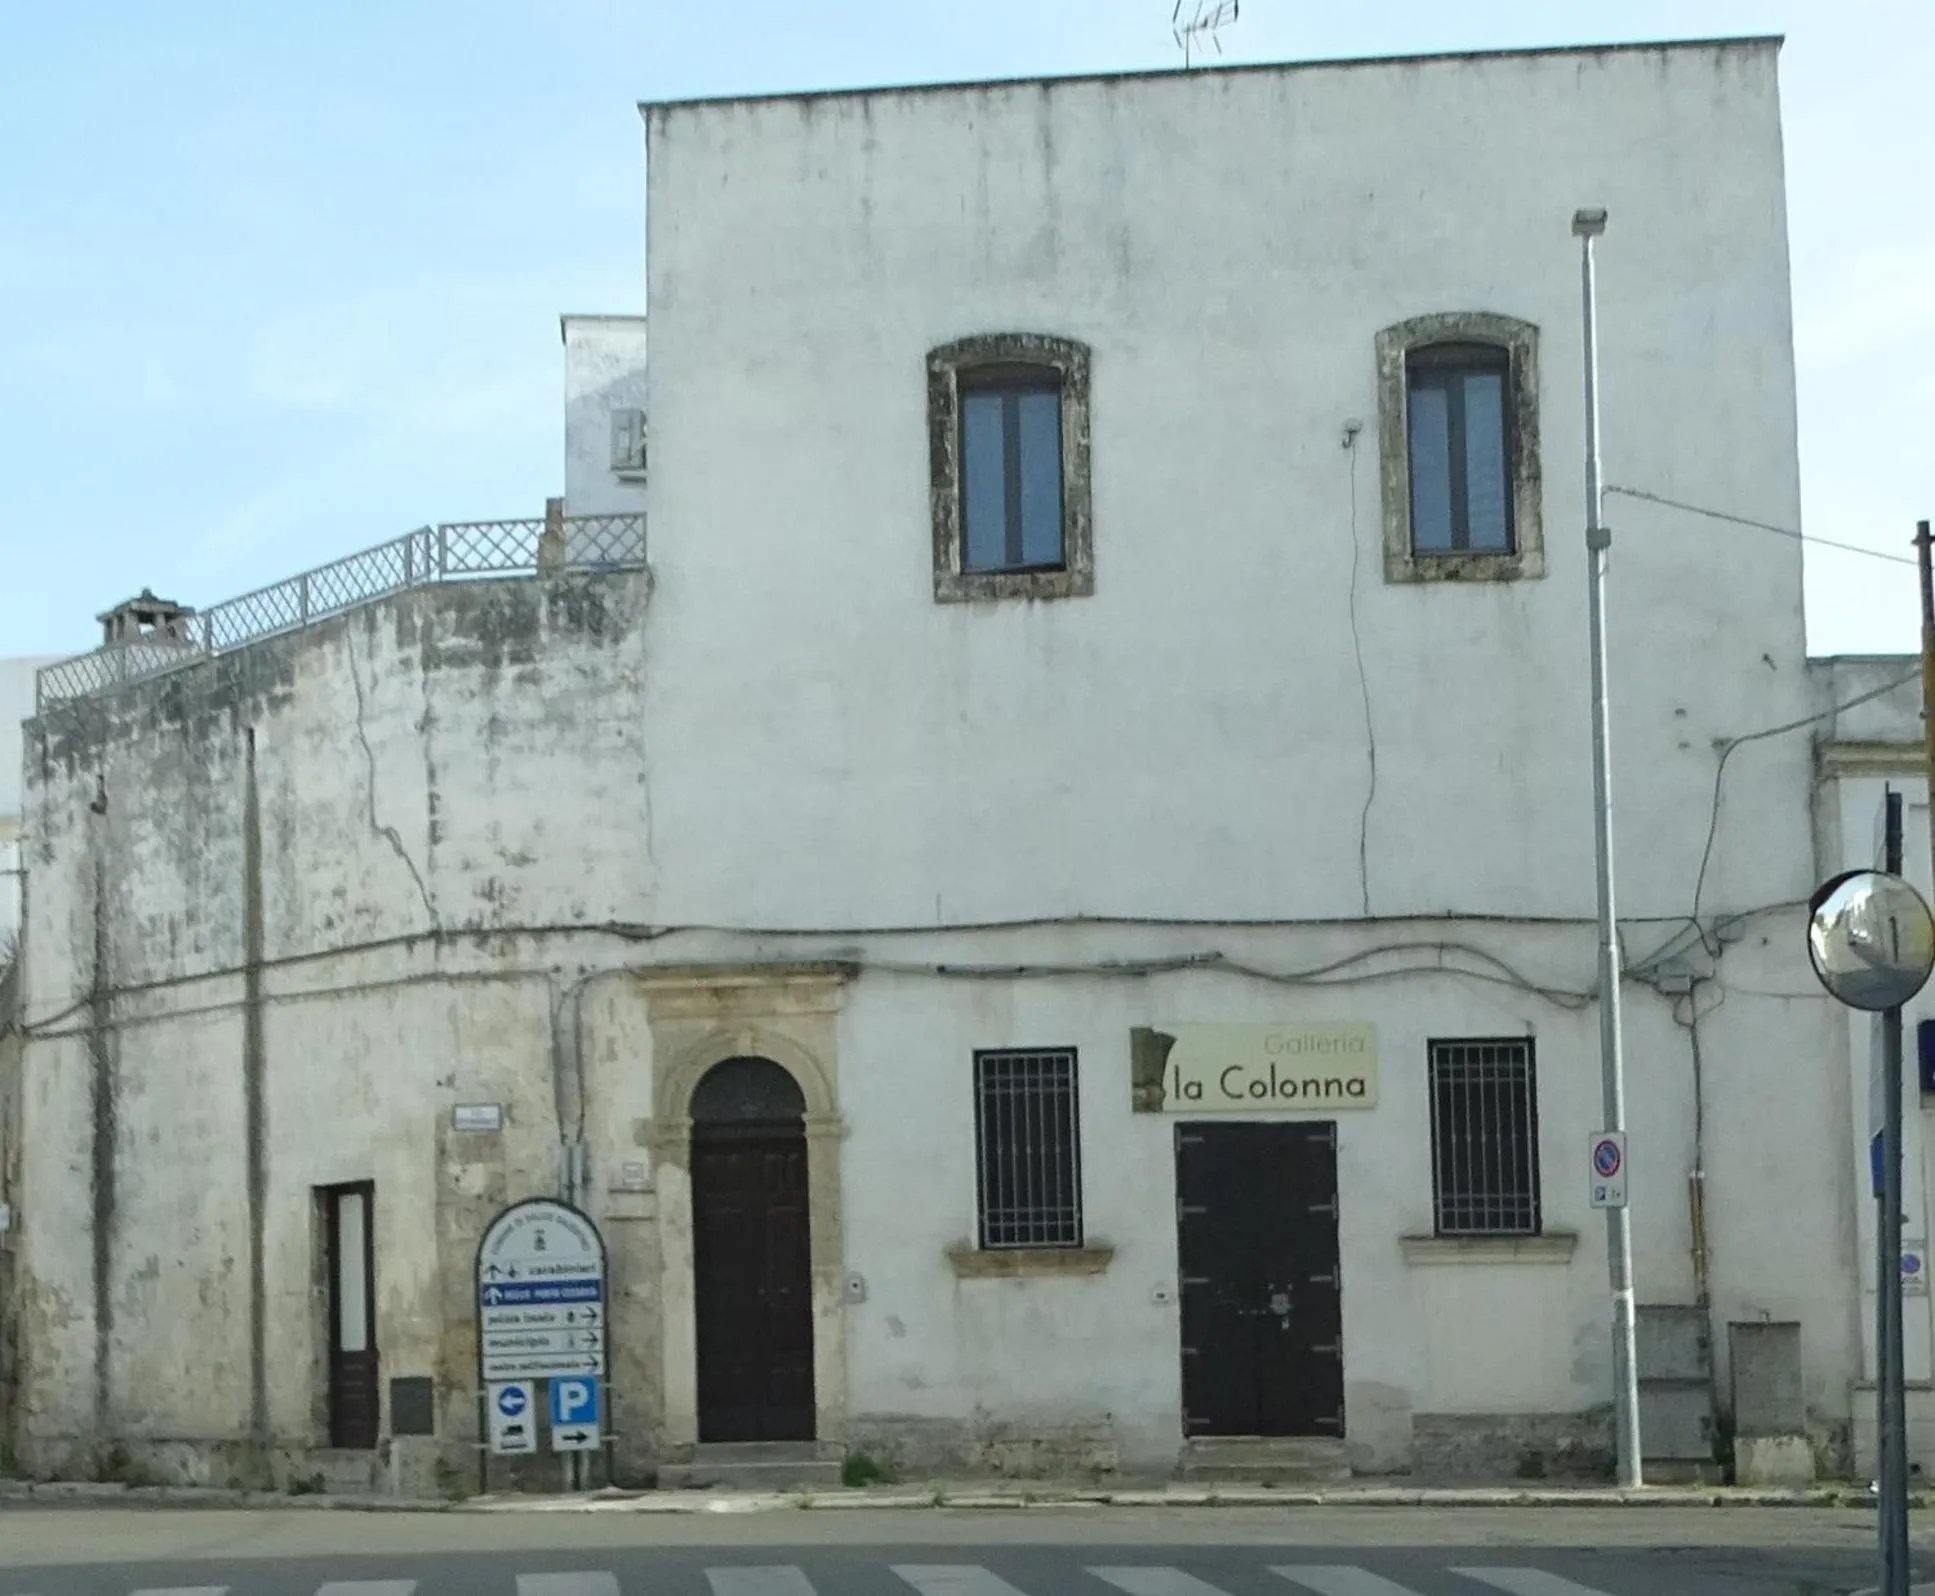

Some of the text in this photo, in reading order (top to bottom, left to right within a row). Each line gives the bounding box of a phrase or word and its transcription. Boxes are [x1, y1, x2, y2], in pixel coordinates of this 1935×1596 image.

[1264, 1033, 1365, 1055] Galleria
[1174, 1062, 1366, 1100] la Colonna
[559, 1382, 588, 1421] P
